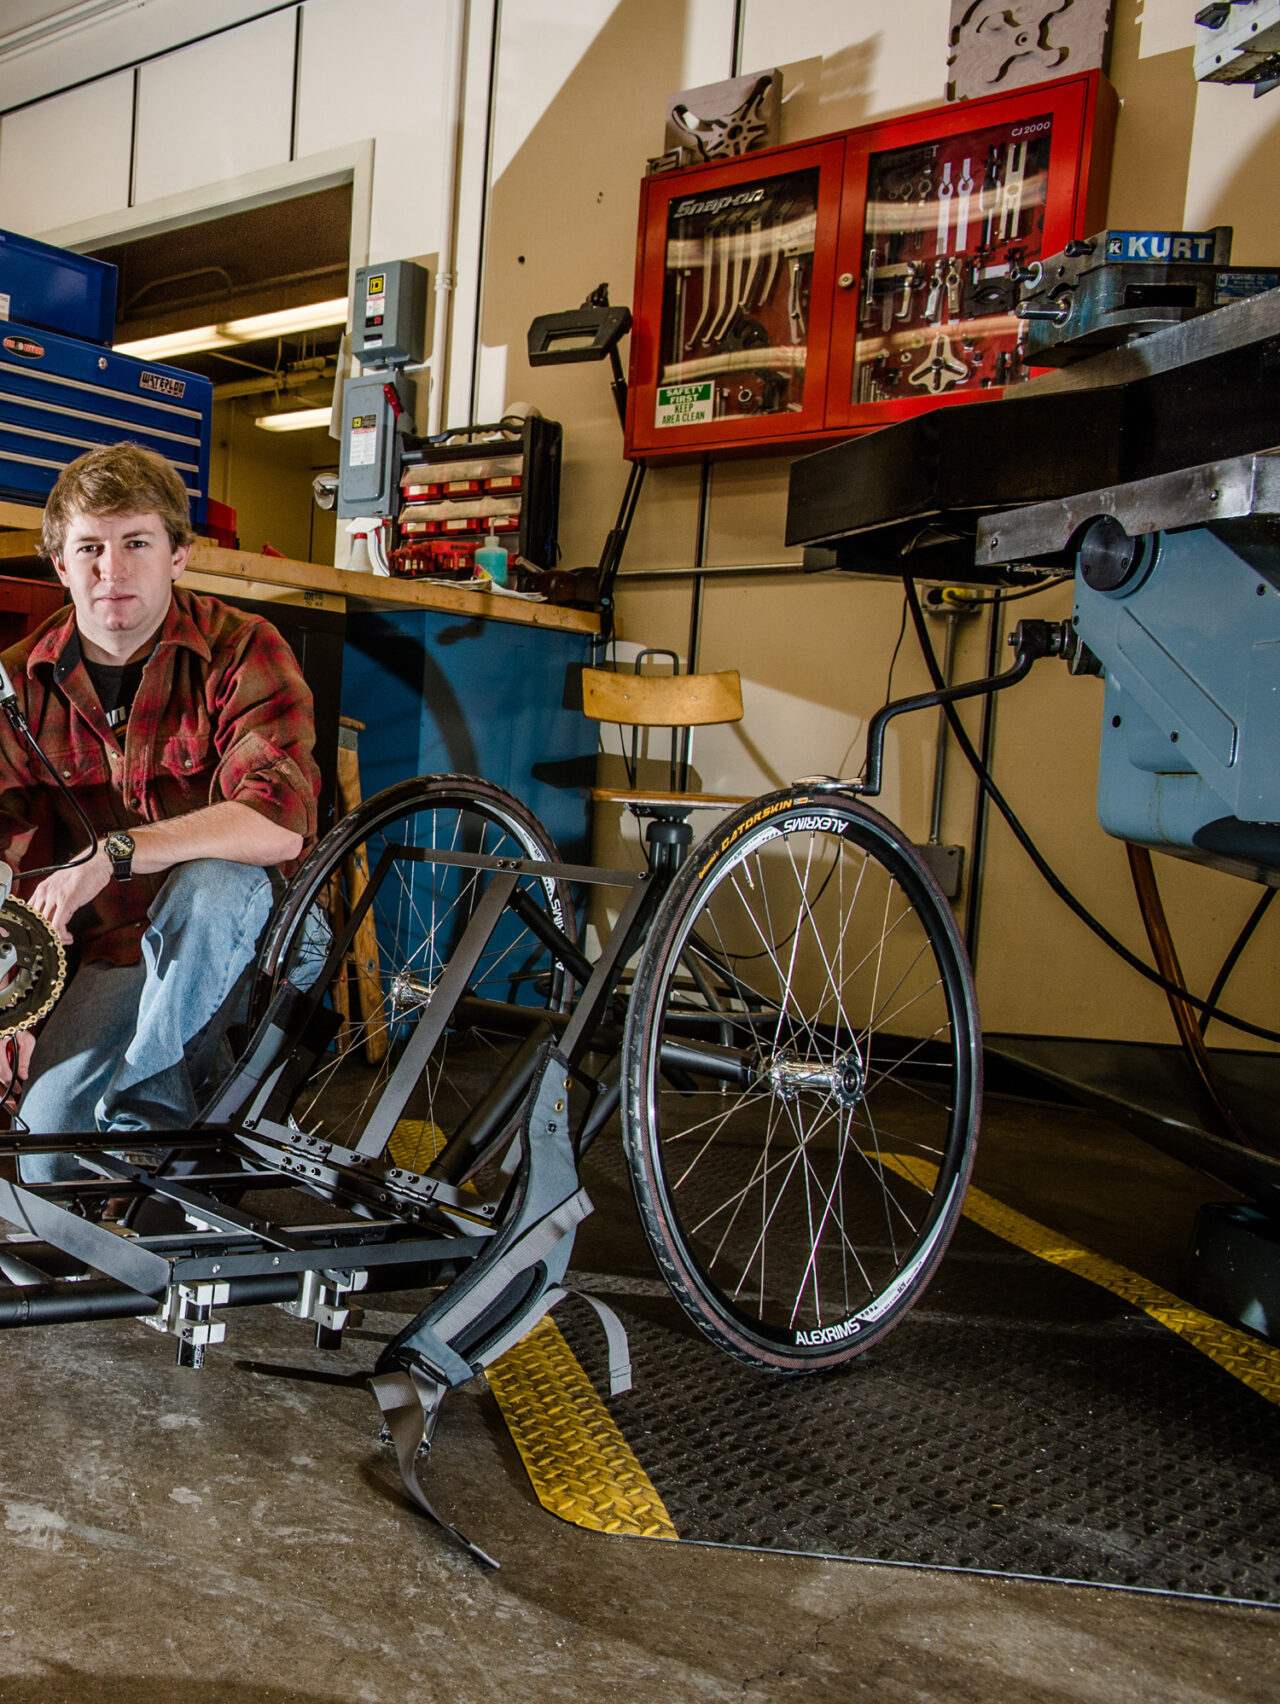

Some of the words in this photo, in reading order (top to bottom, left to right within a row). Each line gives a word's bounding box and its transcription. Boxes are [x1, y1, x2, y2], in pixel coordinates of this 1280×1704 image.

[1127, 236, 1214, 259] KURT
[666, 385, 704, 397] SAFETY
[670, 394, 699, 405] FIRST
[674, 403, 694, 414] KEEP
[662, 413, 681, 425] AREA
[681, 411, 705, 423] CLEAN
[721, 798, 793, 852] GATORSKIN
[783, 815, 850, 835] ALEXRIMS
[794, 1318, 862, 1346] ALEXRIMS
